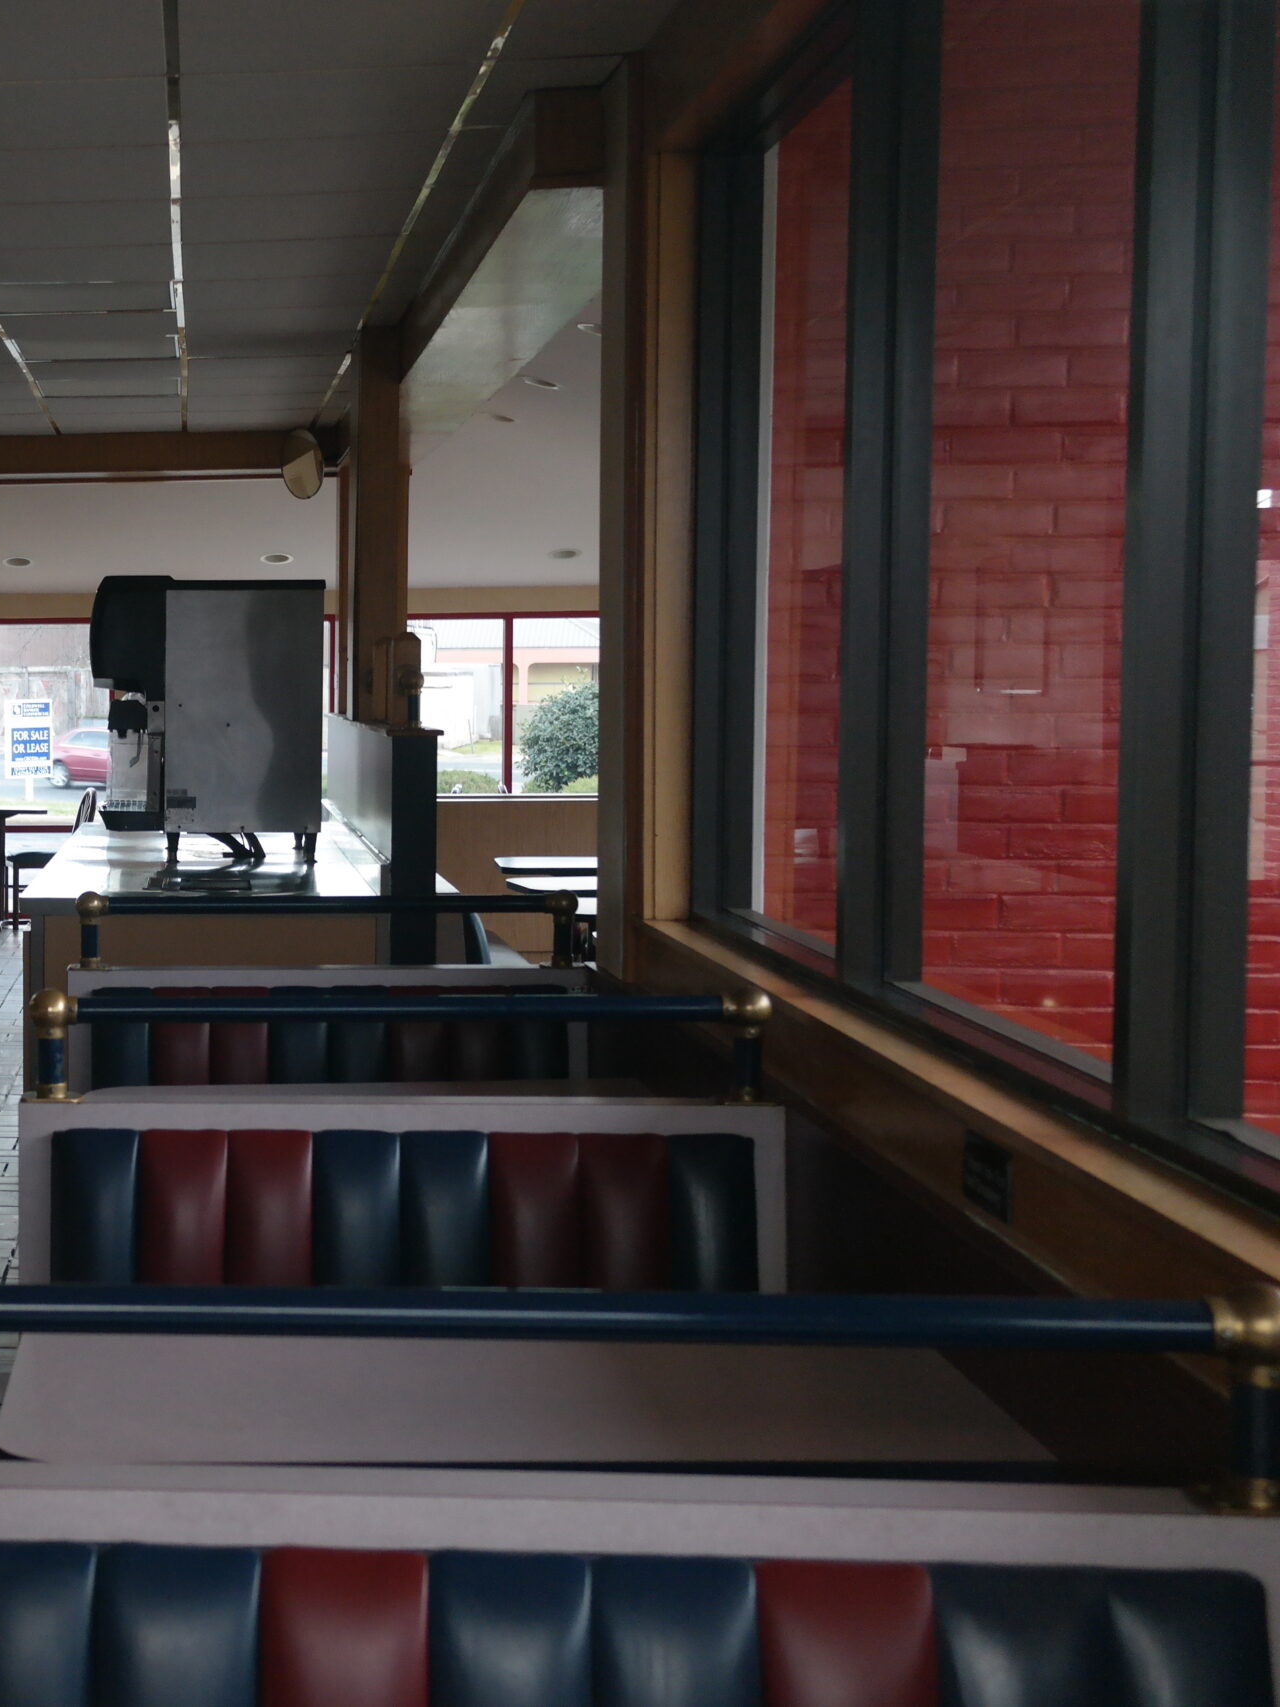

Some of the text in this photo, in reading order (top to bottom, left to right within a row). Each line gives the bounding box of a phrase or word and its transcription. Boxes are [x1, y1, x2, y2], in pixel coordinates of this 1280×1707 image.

[13, 730, 48, 740] FOR SALE
[13, 743, 48, 753] OR LEASE
